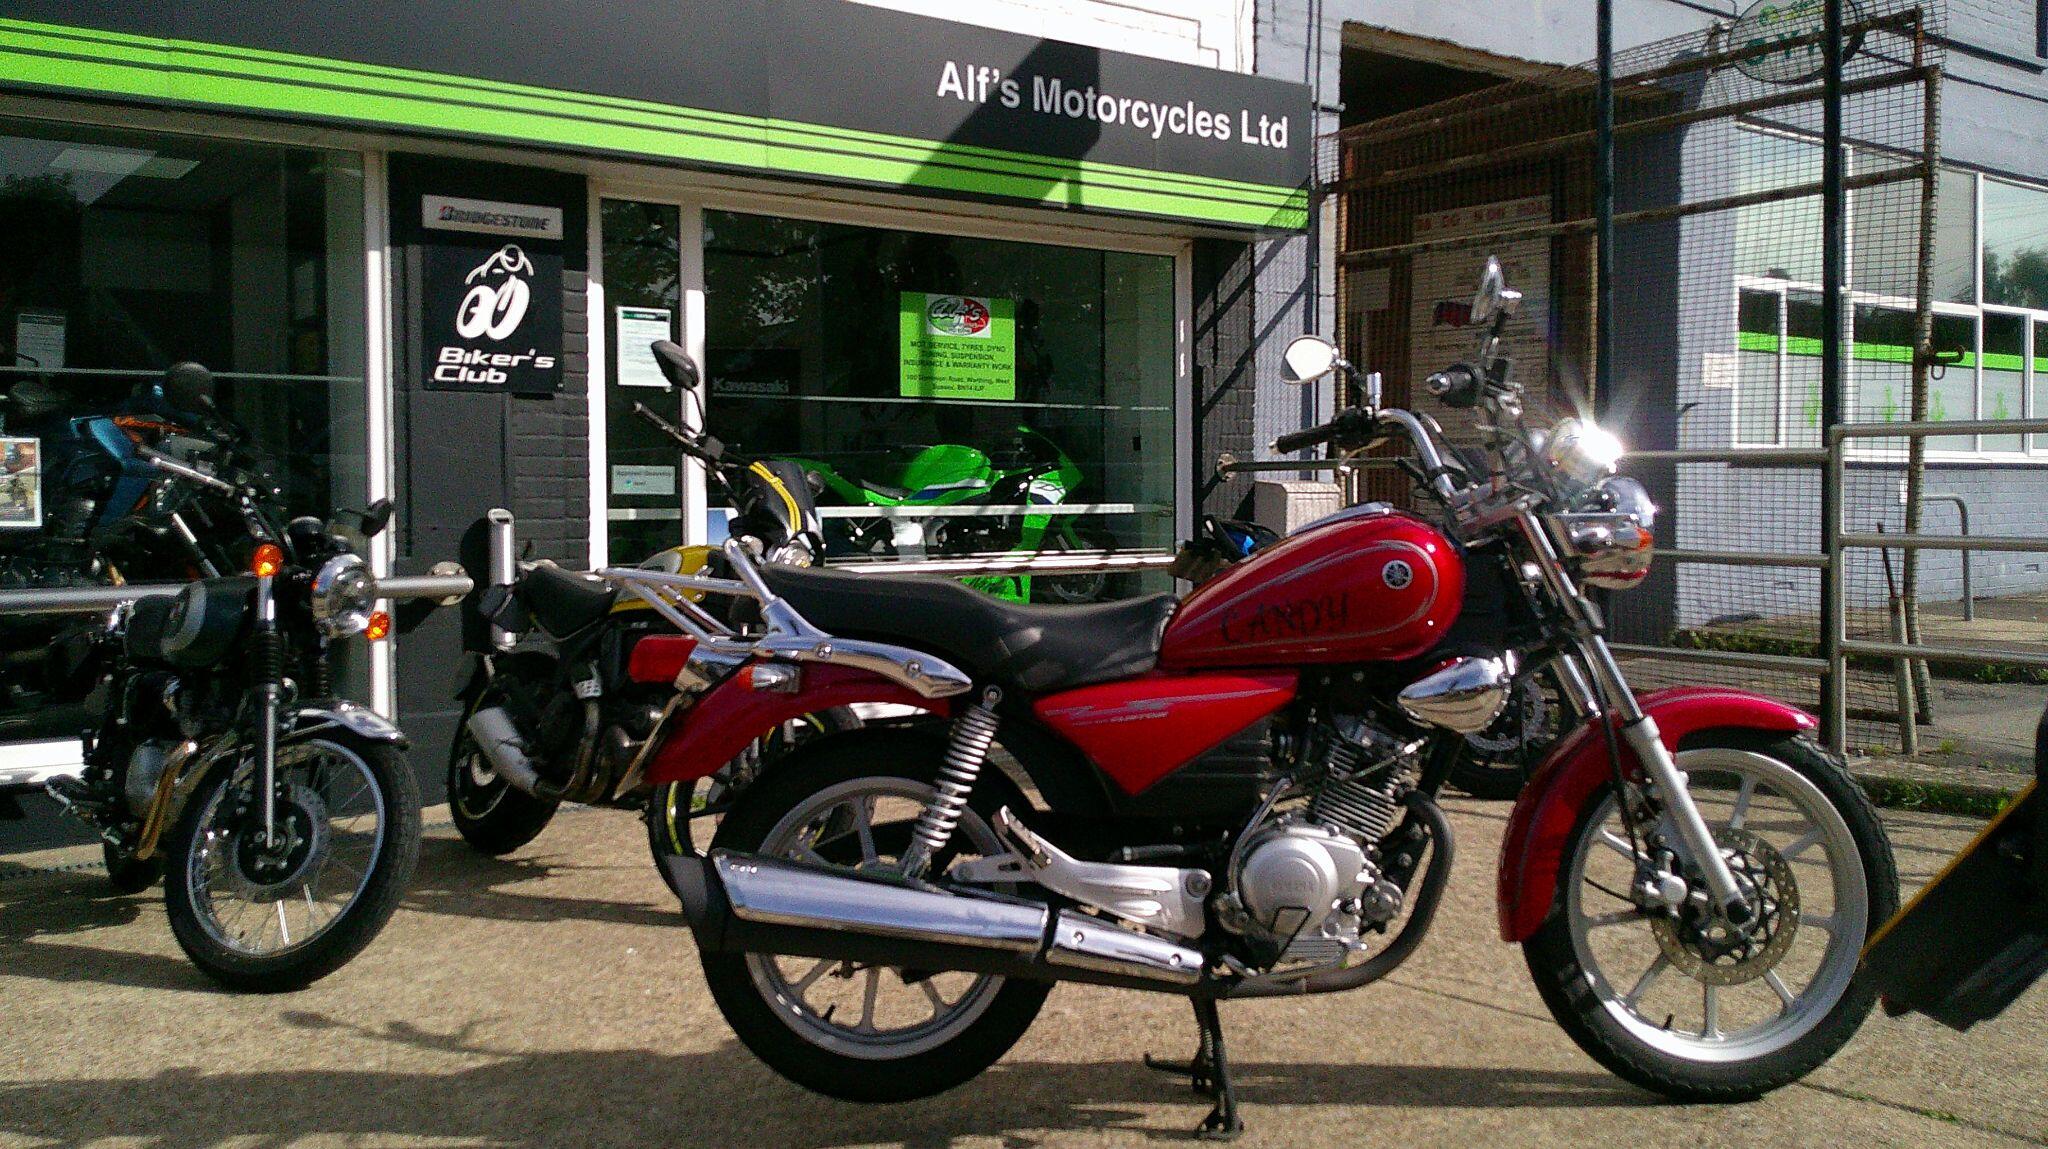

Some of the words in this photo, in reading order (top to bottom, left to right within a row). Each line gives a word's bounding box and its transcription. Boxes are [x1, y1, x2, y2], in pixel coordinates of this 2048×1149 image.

[936, 60, 1020, 109] Alf's
[1032, 75, 1232, 140] Motorcycles
[1241, 109, 1289, 150] Ltd
[438, 205, 551, 231] BRIDGESTONE
[438, 346, 556, 369] Biker's
[952, 361, 989, 369] WARRANTY
[433, 365, 508, 384] Club
[712, 377, 789, 393] Kawasaki
[1221, 592, 1348, 643] CANDY
